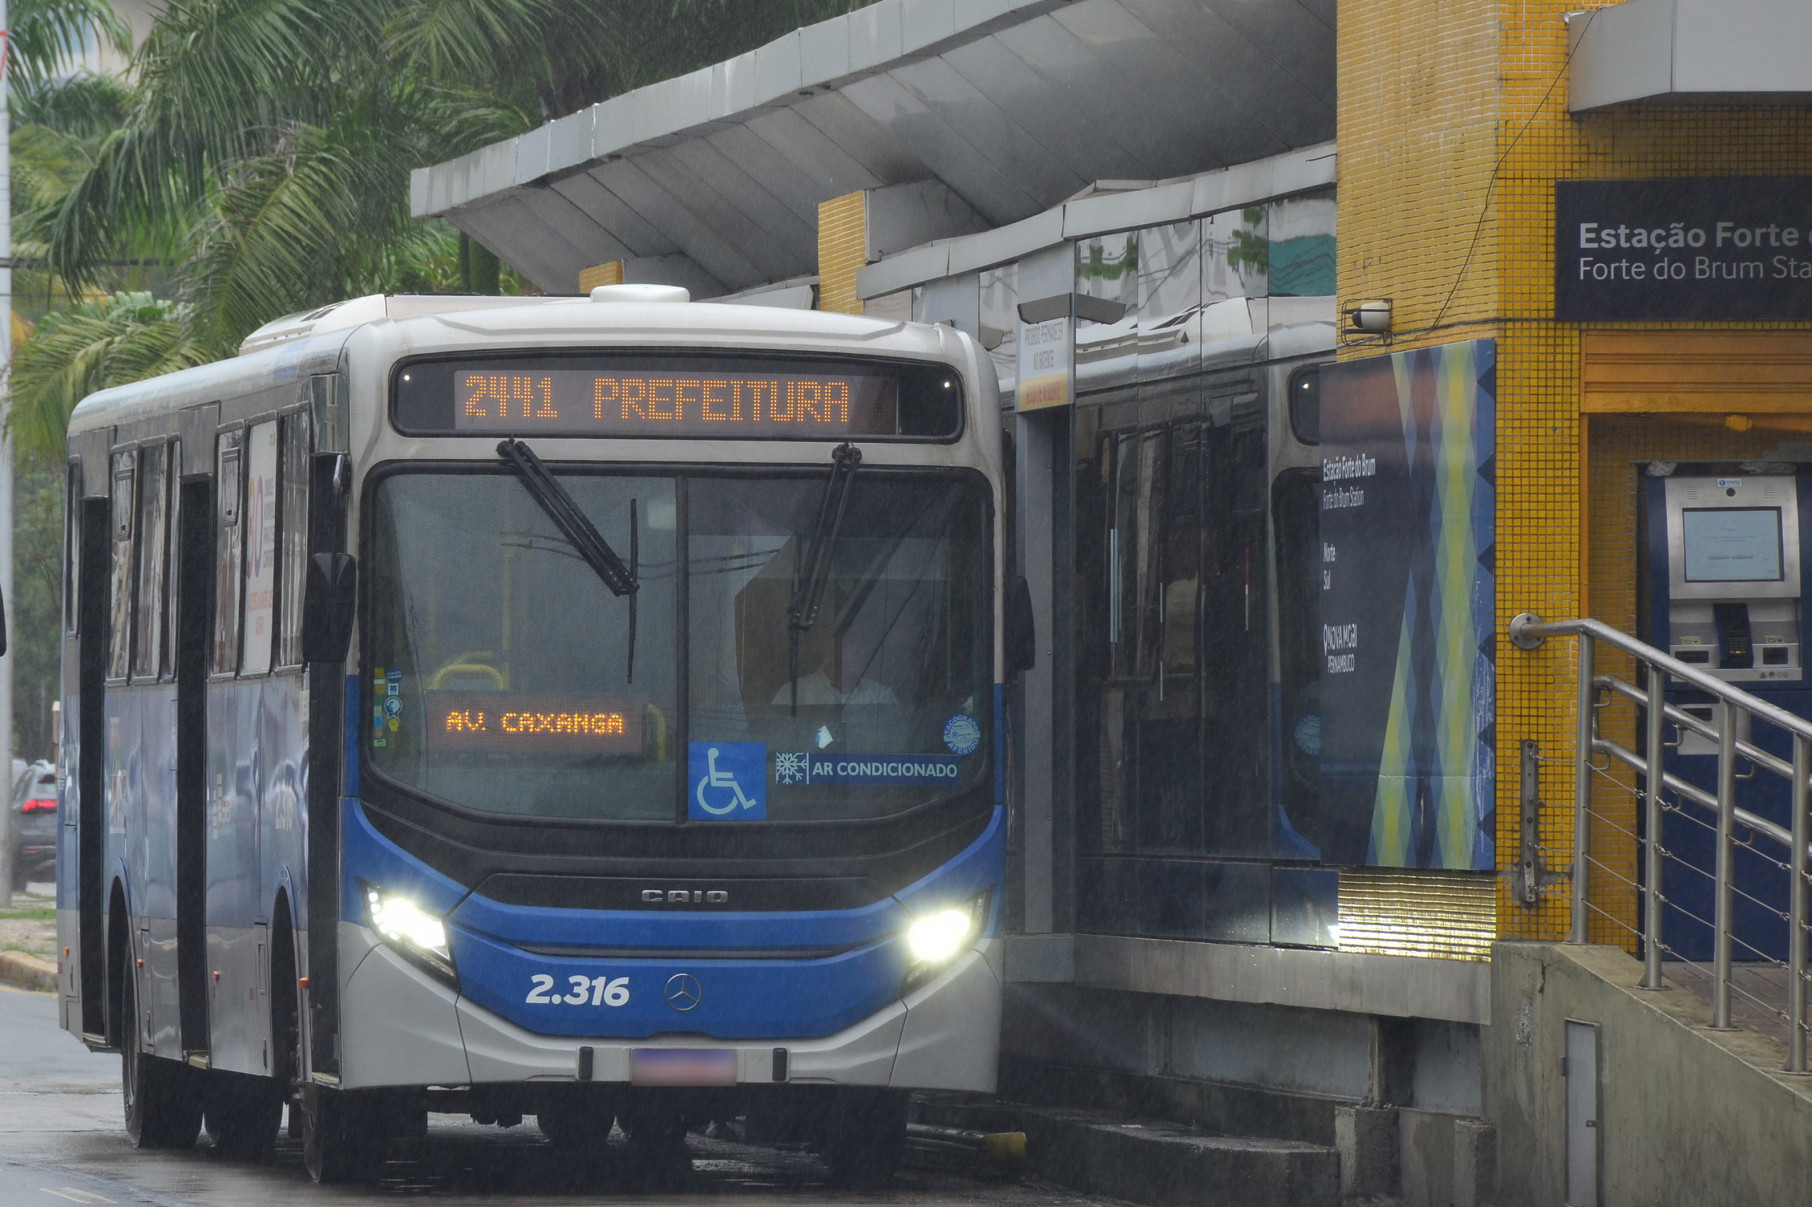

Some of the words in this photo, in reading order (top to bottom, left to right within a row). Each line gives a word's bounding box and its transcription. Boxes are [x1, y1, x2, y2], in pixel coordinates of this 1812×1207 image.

[1579, 222, 1706, 255] Estação
[1716, 221, 1800, 248] Forte
[1579, 257, 1646, 280] Forte
[1653, 257, 1686, 280] do
[1695, 256, 1764, 279] Brum
[1772, 255, 1812, 279] Sta
[465, 375, 558, 418] 2441
[594, 377, 849, 422] PREFEITURA
[1323, 456, 1341, 486] Estação
[1342, 456, 1354, 479] Forte
[1355, 454, 1361, 478] do
[1362, 453, 1375, 476] Brum
[1323, 489, 1333, 510] Forte
[1334, 488, 1339, 509] do
[1339, 487, 1350, 508] Brum
[1350, 486, 1364, 506] Station
[1323, 542, 1336, 562] Norte
[1327, 653, 1355, 674] PERNAMBUCO
[501, 711, 625, 734] CAXANGA
[812, 762, 833, 776] AR
[837, 762, 958, 778] CONDICIONADO
[641, 889, 729, 903] CAIO
[525, 973, 630, 1007] 2.316
